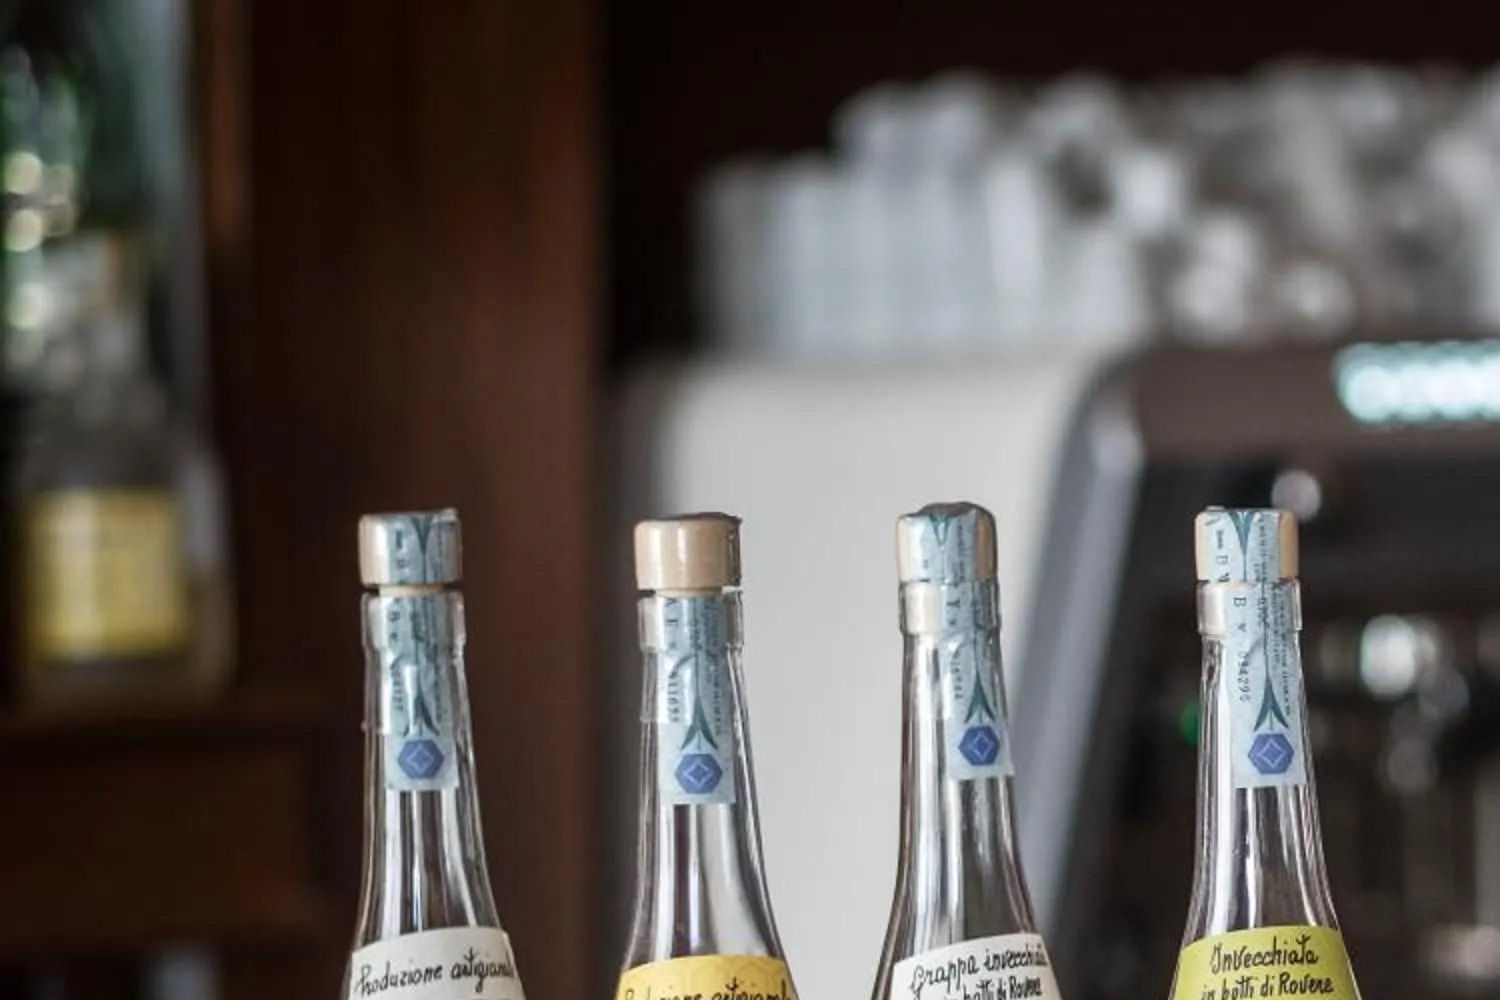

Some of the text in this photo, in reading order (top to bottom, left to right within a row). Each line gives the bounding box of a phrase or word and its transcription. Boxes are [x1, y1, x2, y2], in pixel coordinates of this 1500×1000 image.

[1210, 934, 1319, 975] Invecchiata
[354, 958, 443, 998] Produzione
[1260, 973, 1275, 998] di
[1278, 971, 1335, 1000] Rovere
